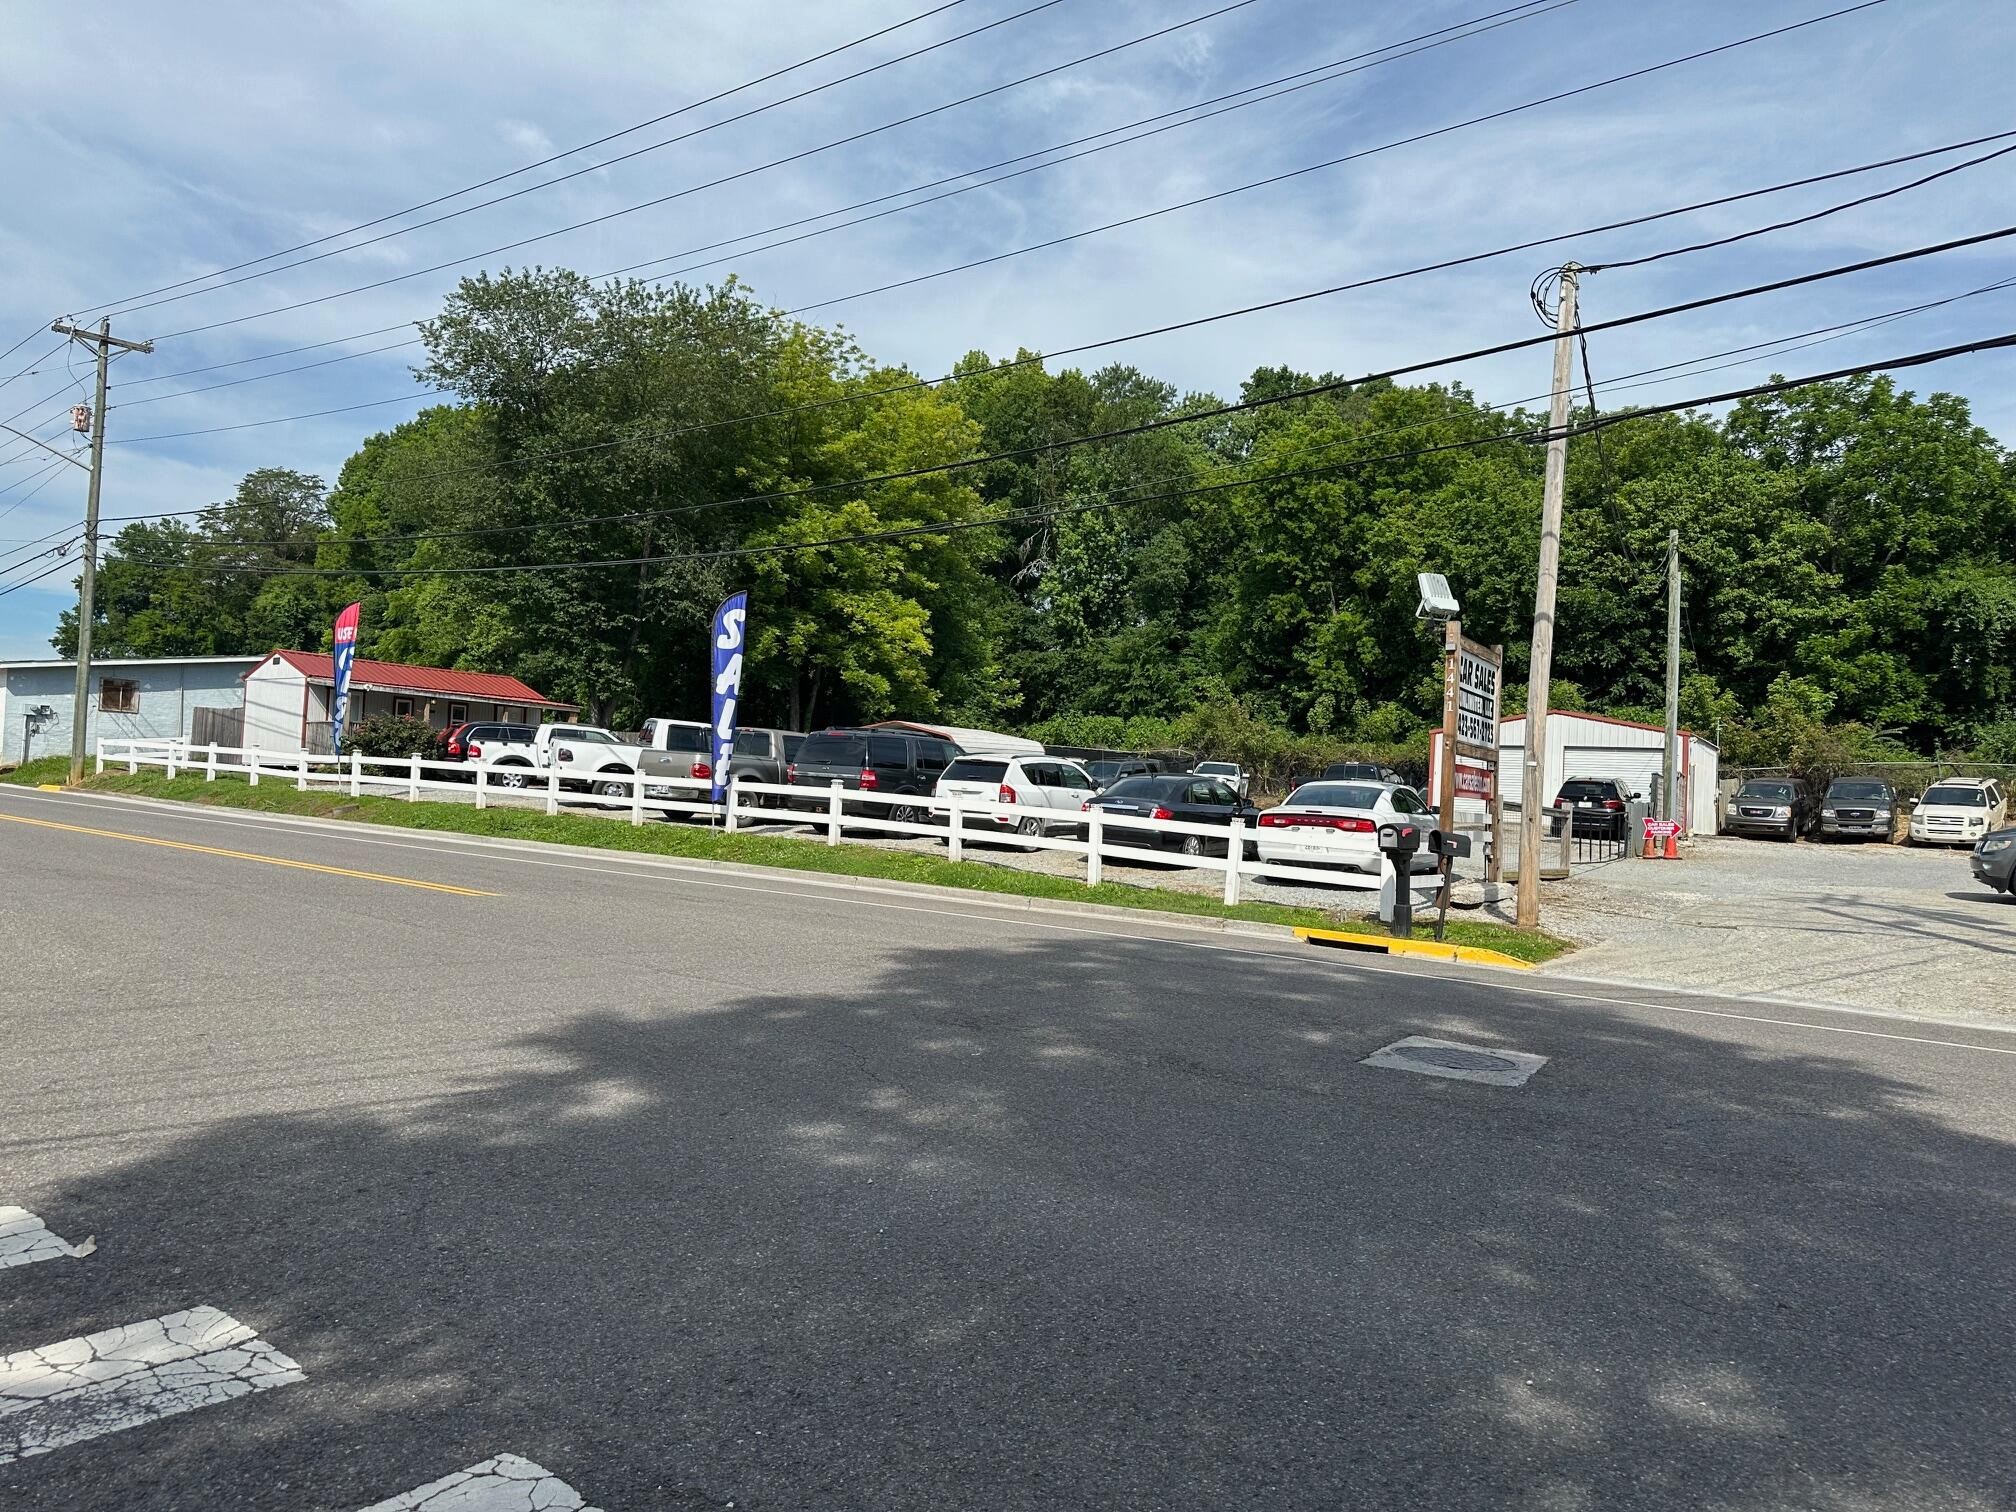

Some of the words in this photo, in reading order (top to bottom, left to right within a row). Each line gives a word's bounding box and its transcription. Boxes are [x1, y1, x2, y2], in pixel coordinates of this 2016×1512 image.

[715, 609, 746, 786] SALE
[1446, 658, 1456, 712] 1441
[1474, 662, 1495, 696] SALES
